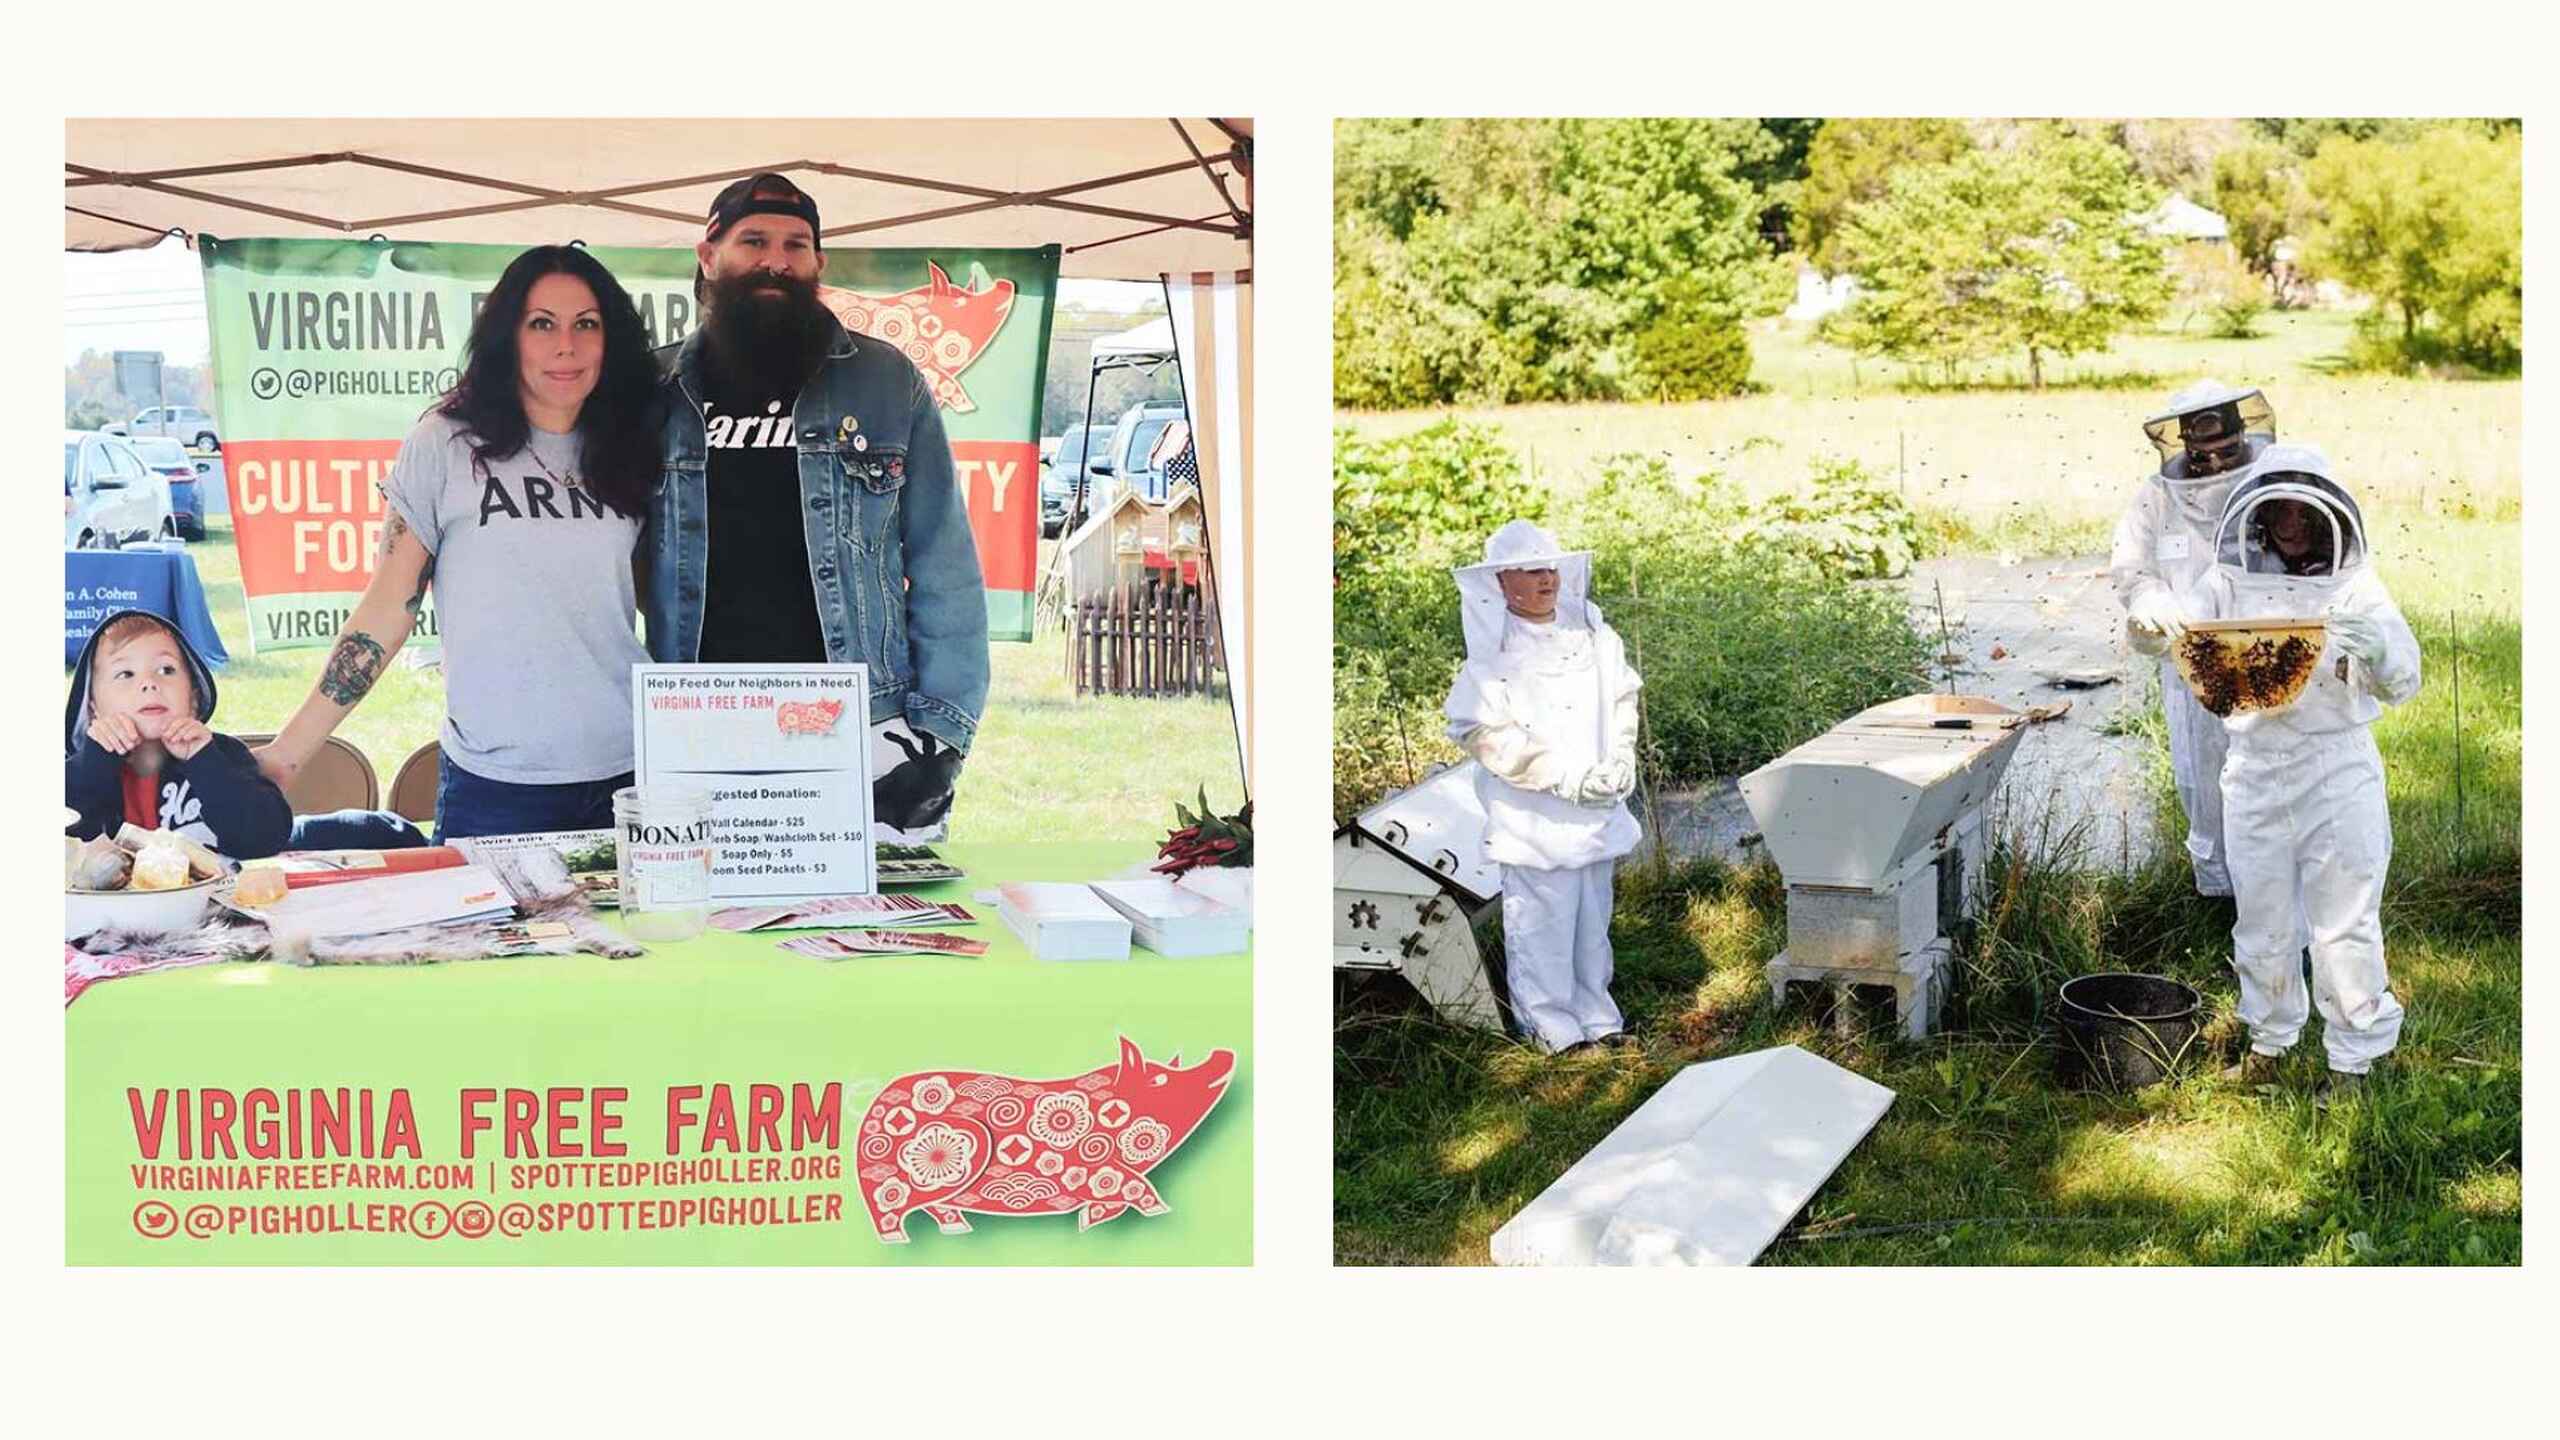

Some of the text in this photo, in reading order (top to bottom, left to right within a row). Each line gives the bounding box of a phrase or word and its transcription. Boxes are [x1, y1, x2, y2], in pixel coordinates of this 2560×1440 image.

[249, 291, 446, 352] VIRGINIA
[285, 368, 434, 399] @PIGHOLLER
[703, 400, 798, 449] arin
[479, 476, 626, 527] ARM
[95, 586, 138, 601] Cohen
[65, 605, 105, 622] amily
[647, 677, 856, 689] Help Feed Our Neighbors in Need.
[651, 695, 774, 710] VIRGINIA FREE FARM
[712, 788, 822, 801] gested Donation:
[732, 818, 778, 828] Calendar
[765, 832, 817, 843] Washcloth
[820, 832, 837, 842] Set
[721, 850, 748, 861] Soap
[750, 849, 773, 860] Only
[712, 867, 736, 875] oom
[737, 865, 763, 875] Seed
[765, 864, 806, 874] Packets
[127, 1082, 843, 1161] VIRGINIA FREE FARM
[130, 1163, 474, 1191] VIRGINIAFREEFARM.COM
[510, 1155, 841, 1190] SPOTTEDPIGHOLLER.ORG
[184, 1202, 408, 1239] @PIGHOLLER
[498, 1194, 843, 1238] @SPOTTEDPIGHOLLER
